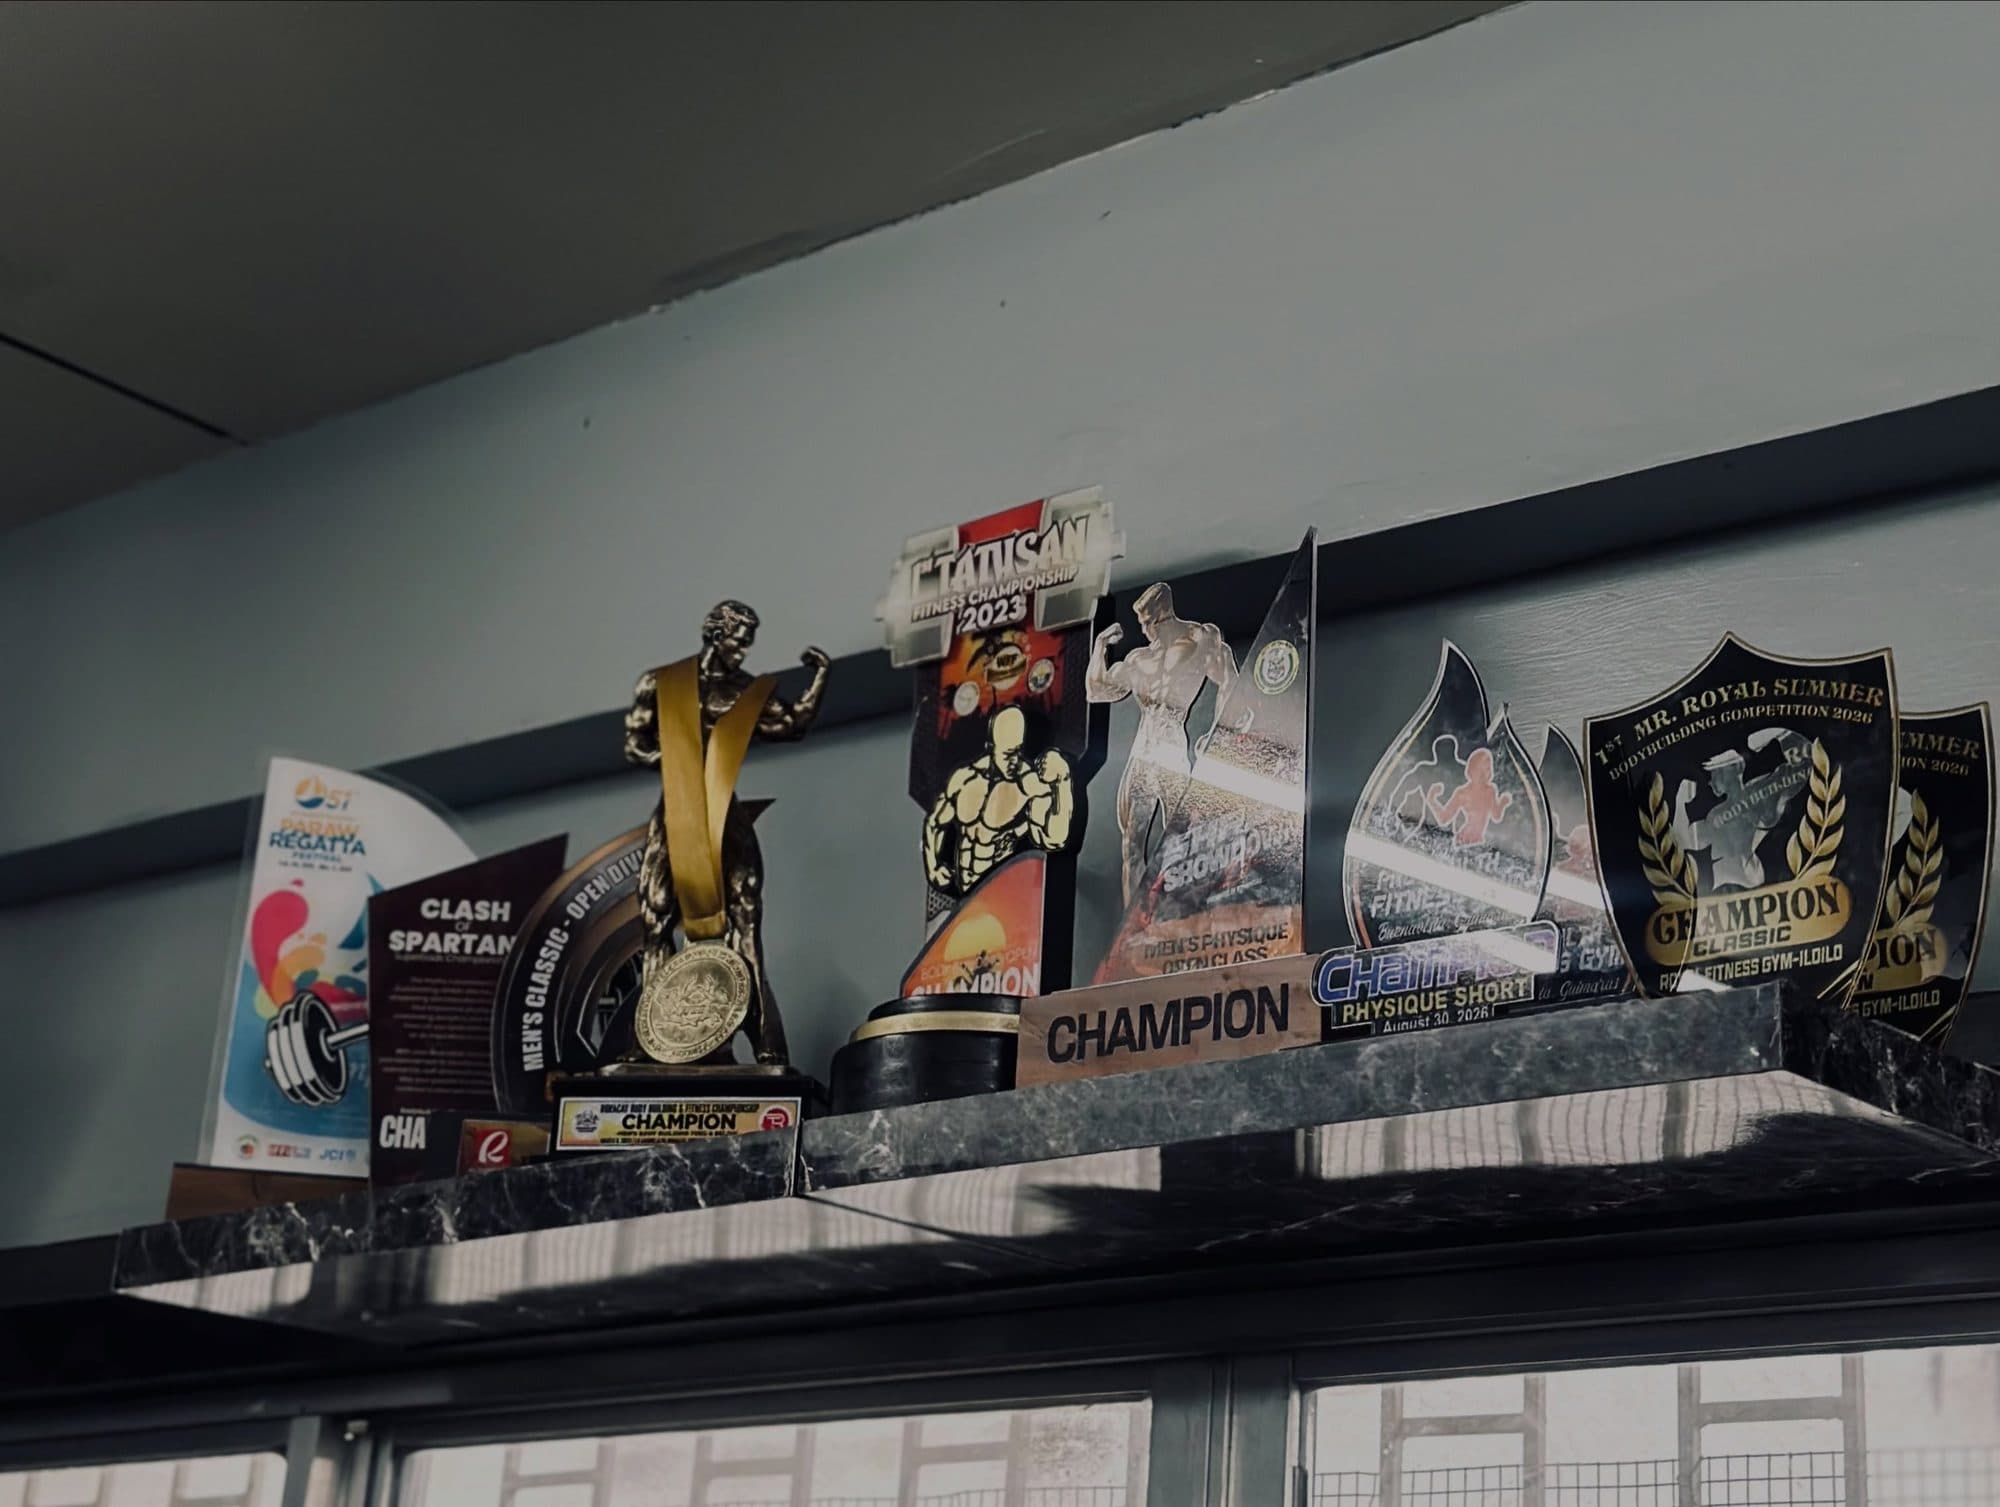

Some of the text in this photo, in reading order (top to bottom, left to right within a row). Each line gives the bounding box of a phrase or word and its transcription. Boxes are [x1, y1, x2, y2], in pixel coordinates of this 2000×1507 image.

[911, 594, 967, 623] FITNESS
[968, 567, 1080, 606] CHAMPIONSHIP
[959, 595, 1027, 633] 2023
[1634, 709, 1678, 741] MR.
[1681, 680, 1767, 717] ROYAL
[1773, 678, 1884, 708] SUMMER
[1608, 704, 1873, 781] BODYBUILDING COMPETITION 2026
[1900, 731, 1980, 760] MMER
[1711, 767, 1812, 829] BODYBUILDIN
[268, 831, 367, 856] REGATTA
[420, 898, 512, 922] CLASH
[565, 874, 612, 921] OPEN
[1652, 881, 1841, 945] CHAMPION
[388, 929, 518, 956] SPARTAN
[1202, 922, 1289, 951] PHYSIQUE
[1692, 924, 1792, 957] CLASSIC
[524, 926, 570, 1009] CLASSIC
[1704, 957, 1760, 984] FITNESS
[1342, 990, 1448, 1023] PHYSIQUE
[1455, 976, 1529, 1006] SHORT
[522, 1011, 545, 1072] MEN'S
[1046, 982, 1290, 1064] CHAMPION
[379, 1114, 427, 1150] CHA
[621, 1113, 737, 1130] CHAMPION
